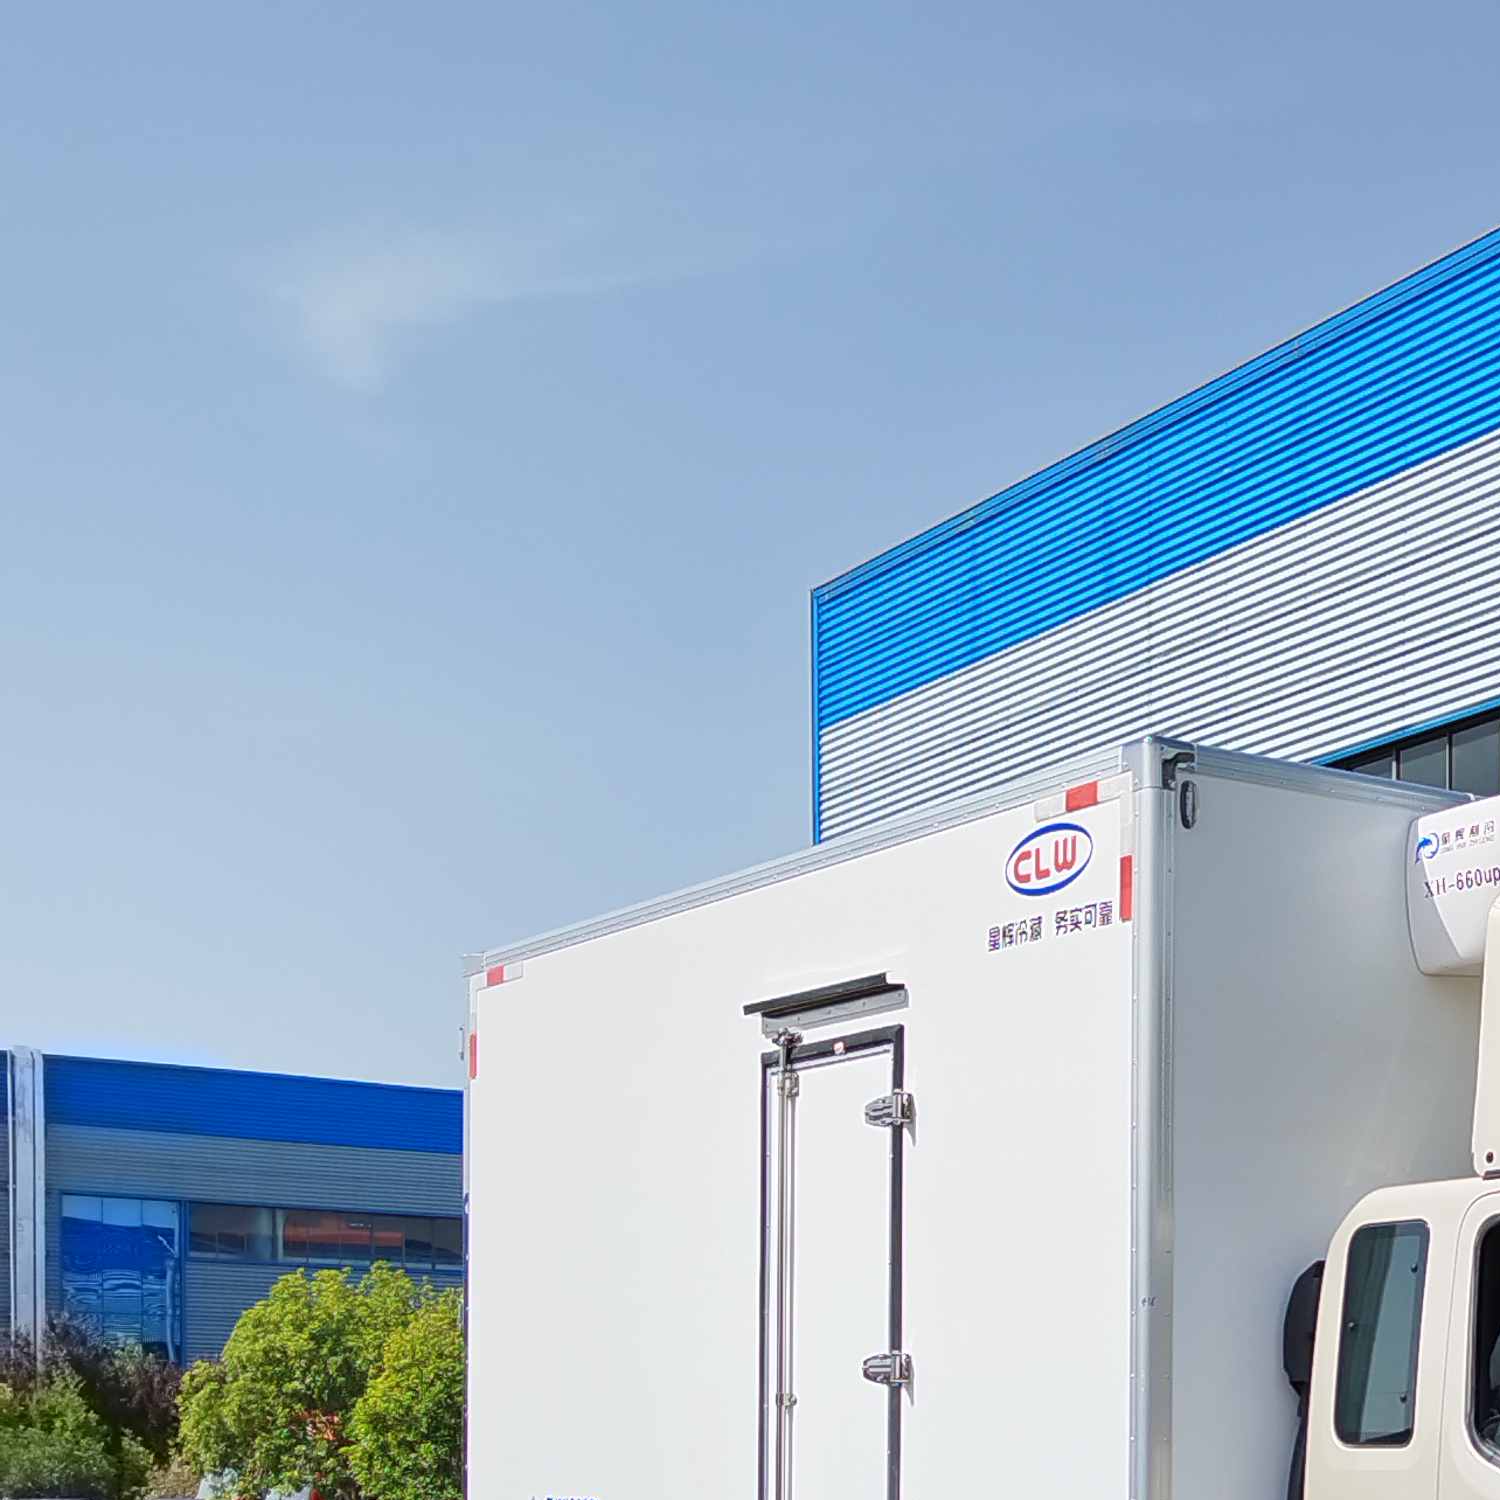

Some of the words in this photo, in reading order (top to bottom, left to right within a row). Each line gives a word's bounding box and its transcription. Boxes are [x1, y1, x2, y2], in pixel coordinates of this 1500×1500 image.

[1014, 835, 1077, 883] CLW
[988, 915, 1043, 952] 星辉冷藏
[1055, 900, 1113, 937] 务实可靠
